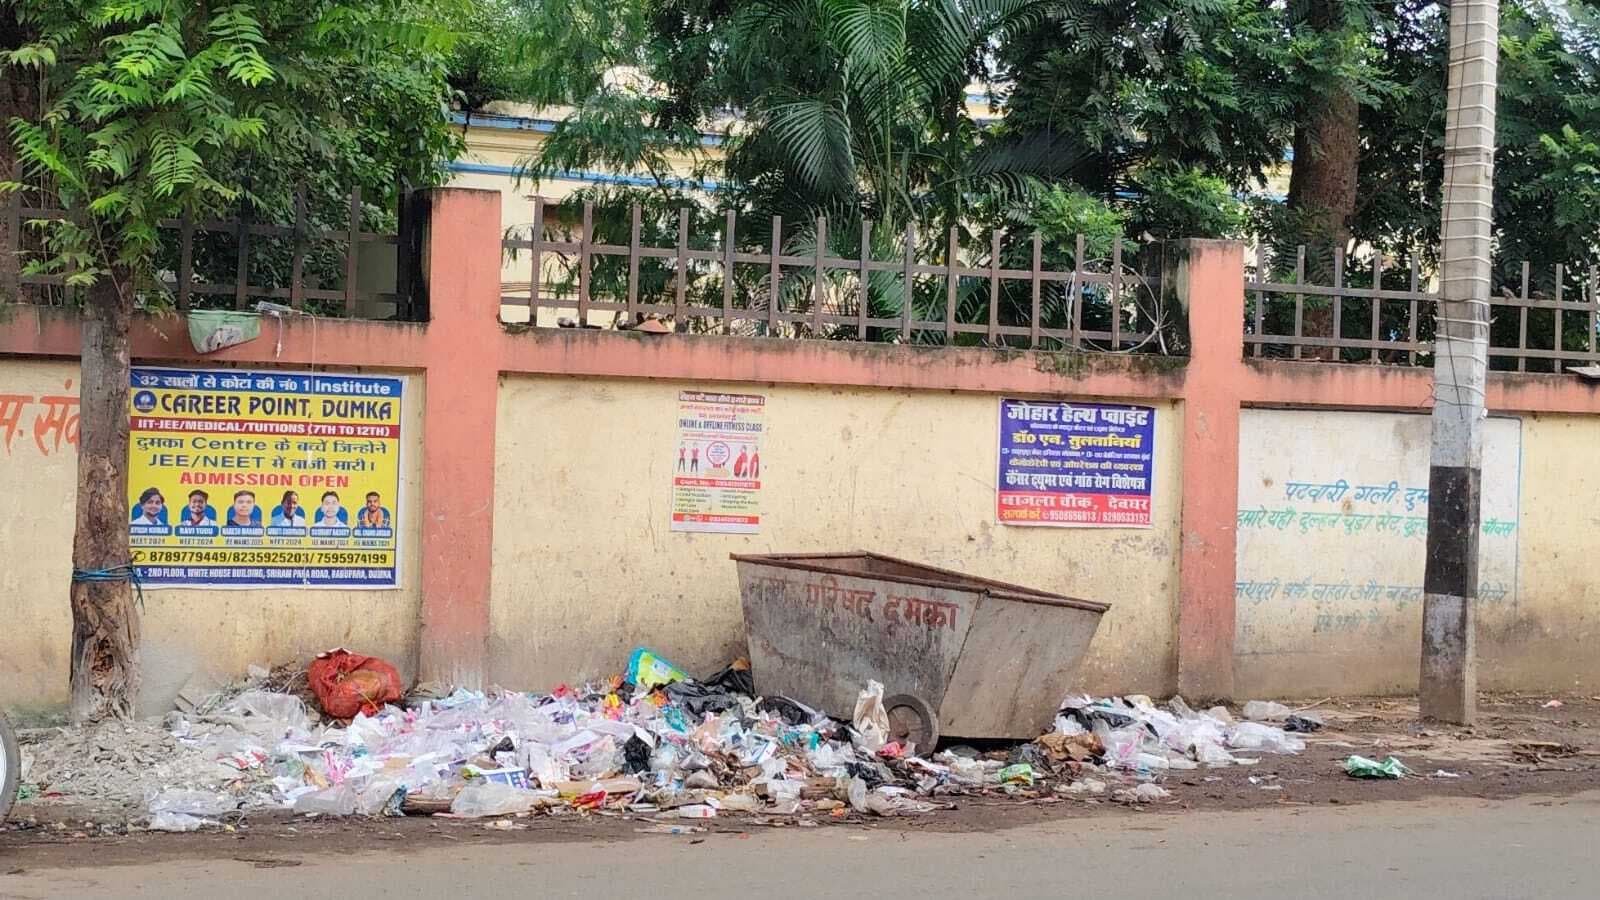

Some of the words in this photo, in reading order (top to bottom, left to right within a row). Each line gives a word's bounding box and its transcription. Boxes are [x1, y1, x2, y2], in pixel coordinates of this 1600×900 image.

[140, 375, 159, 386] 32
[164, 374, 198, 388] सालों
[203, 376, 217, 388] से
[221, 374, 252, 390] कोटा
[256, 376, 274, 390] की
[315, 380, 391, 395] Institute
[161, 395, 241, 416] CAREER
[248, 397, 313, 418] POINT,
[321, 399, 392, 420] DUMKA
[1006, 401, 1058, 422] जोहार
[1060, 402, 1097, 424] हेल्थ
[137, 421, 306, 434] IIT-JEE/MEDICAL/TUITIONS
[308, 423, 337, 435] (7TH
[338, 424, 354, 435] TO
[356, 425, 390, 437] 12TH)
[745, 423, 763, 432] CLASS
[136, 436, 184, 451] दुमका
[191, 436, 266, 451] Centre
[274, 437, 291, 452] के
[148, 454, 265, 469] JEE/NEET
[271, 454, 284, 469] में
[291, 456, 326, 471] बाजी
[179, 471, 294, 487] ADMISSION
[297, 473, 350, 489] OPEN
[1285, 479, 1350, 503] पटवारी
[1403, 487, 1431, 511] दुम
[188, 567, 209, 578] WHITE
